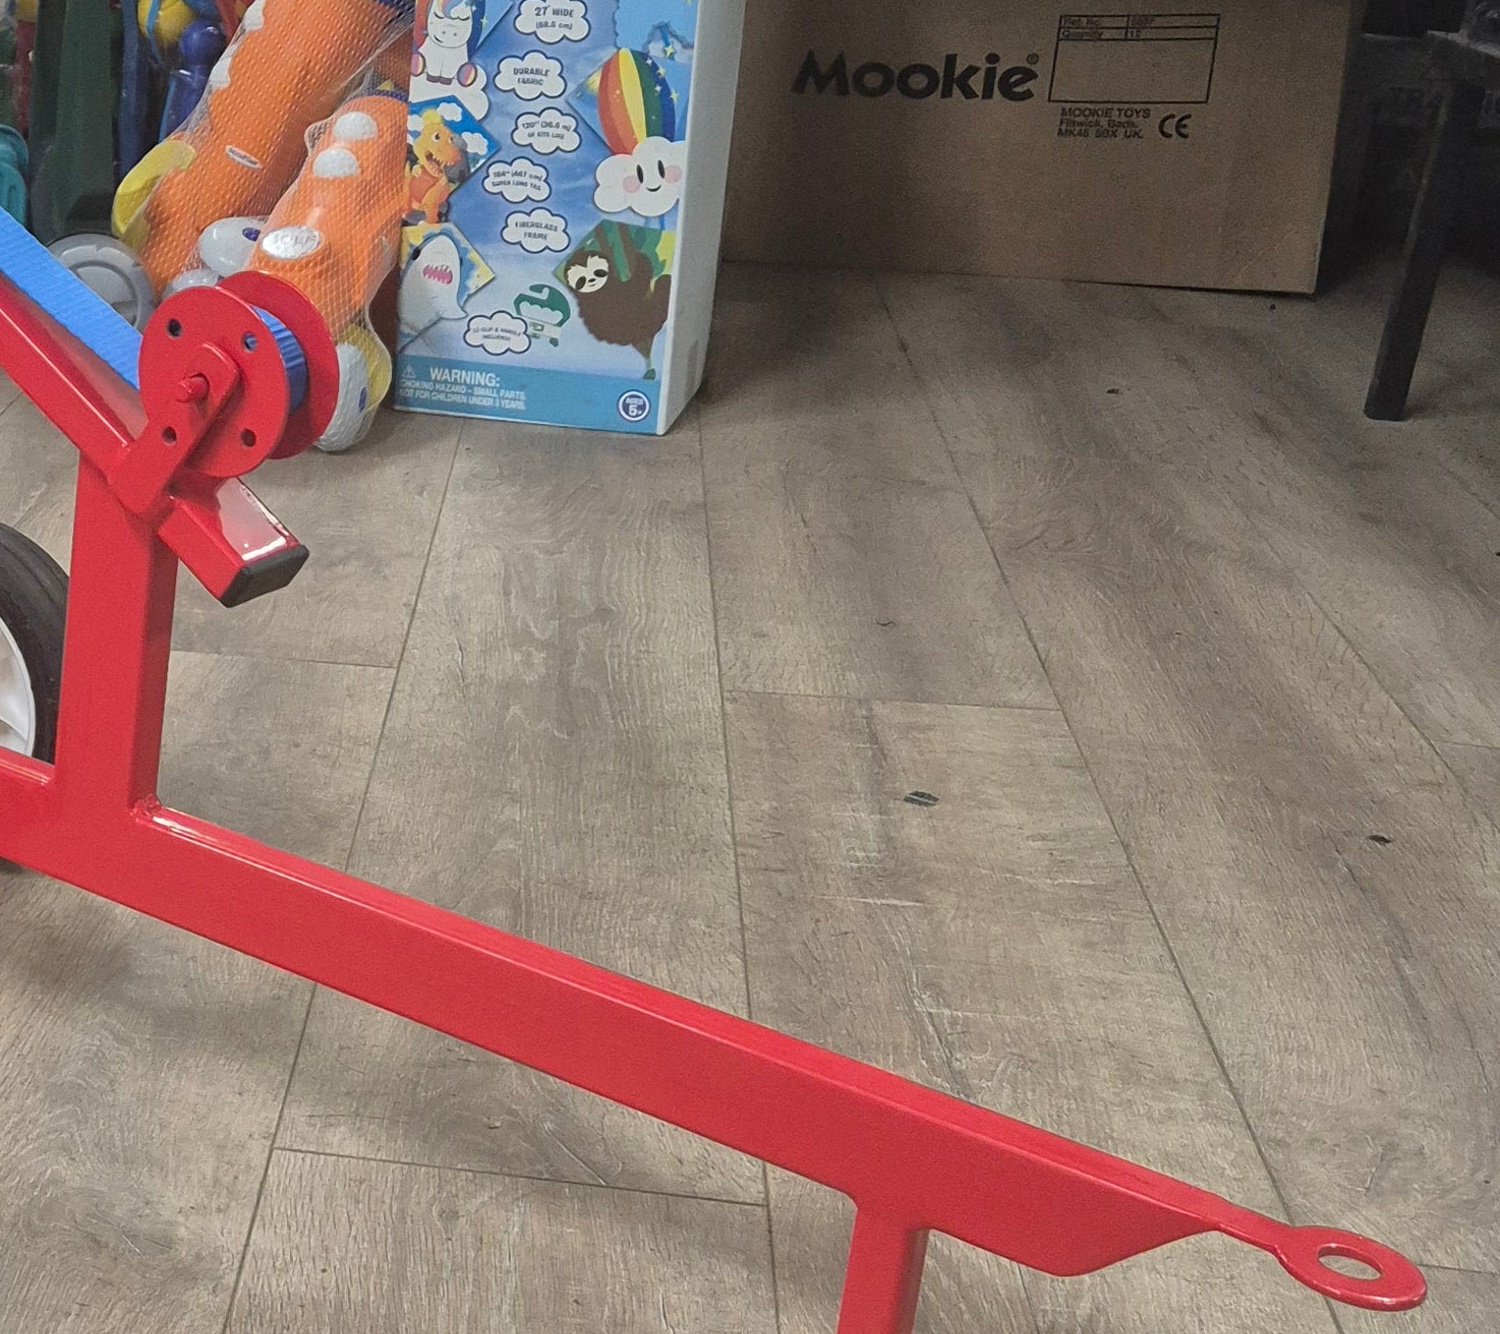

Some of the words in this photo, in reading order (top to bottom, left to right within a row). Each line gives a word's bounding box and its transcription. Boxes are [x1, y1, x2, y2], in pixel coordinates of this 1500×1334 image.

[552, 7, 575, 18] WIDE
[513, 67, 550, 78] DURABLE
[790, 48, 1039, 102] Mookie
[517, 77, 544, 87] FABRIC
[1061, 107, 1114, 118] MOOKIE
[1117, 107, 1152, 119] TOYS
[515, 221, 558, 233] FIBERGLASS
[523, 232, 548, 241] FRAME
[430, 367, 501, 388] WARNING:
[435, 384, 466, 394] HAZARD
[473, 387, 498, 398] SMALL
[415, 389, 431, 400] FOR
[431, 392, 467, 404] CHILDREN
[468, 396, 494, 407] UNDER
